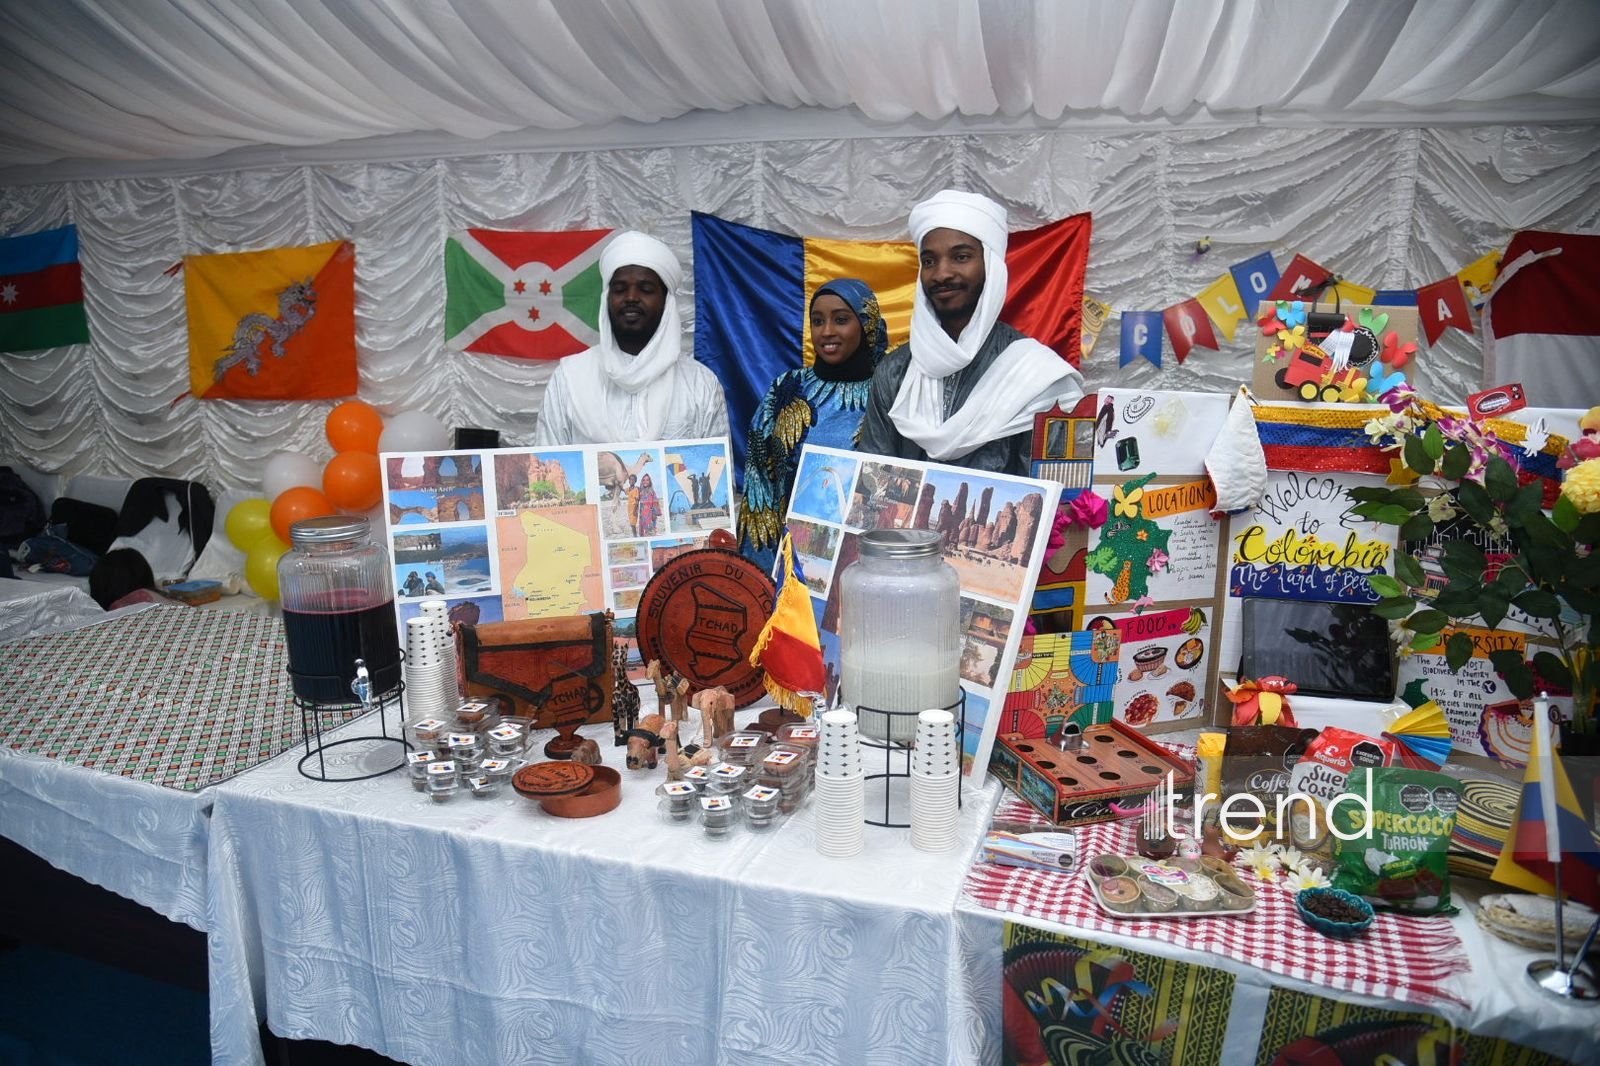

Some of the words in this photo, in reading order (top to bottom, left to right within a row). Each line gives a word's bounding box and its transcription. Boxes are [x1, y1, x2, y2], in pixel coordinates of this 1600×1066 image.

[1149, 486, 1205, 514] LOCATION
[1295, 511, 1325, 534] to
[1235, 526, 1386, 568] Colombia
[650, 563, 703, 619] SOUVENIR
[724, 565, 744, 580] DU
[1235, 565, 1270, 591] The
[1325, 573, 1337, 592] of
[699, 617, 738, 634] TCHAD
[1126, 617, 1167, 638] FOOD
[1415, 655, 1431, 665] The
[553, 687, 588, 707] TCHAD
[1348, 809, 1454, 837] SUPERCOCO
